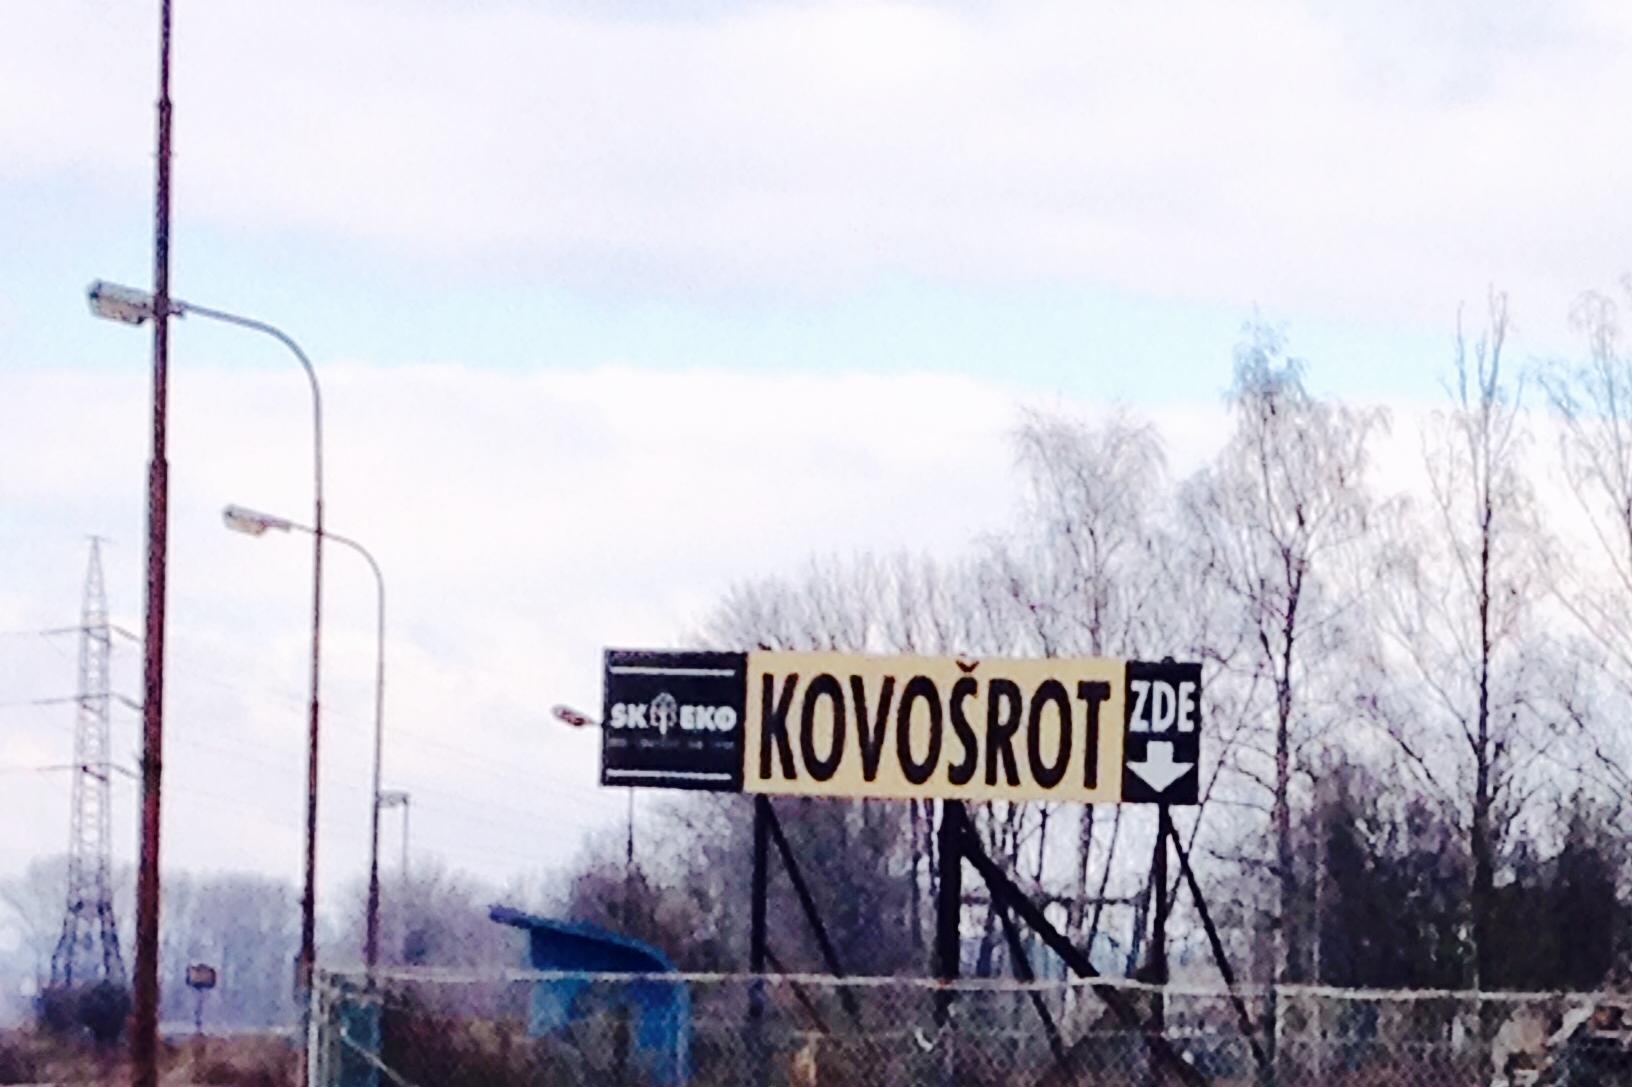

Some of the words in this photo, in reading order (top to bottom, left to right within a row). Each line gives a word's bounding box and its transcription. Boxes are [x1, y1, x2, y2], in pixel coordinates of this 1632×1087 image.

[679, 704, 737, 732] EKO
[759, 660, 1111, 789] KOVOŠROT
[1129, 680, 1197, 733] ZDE
